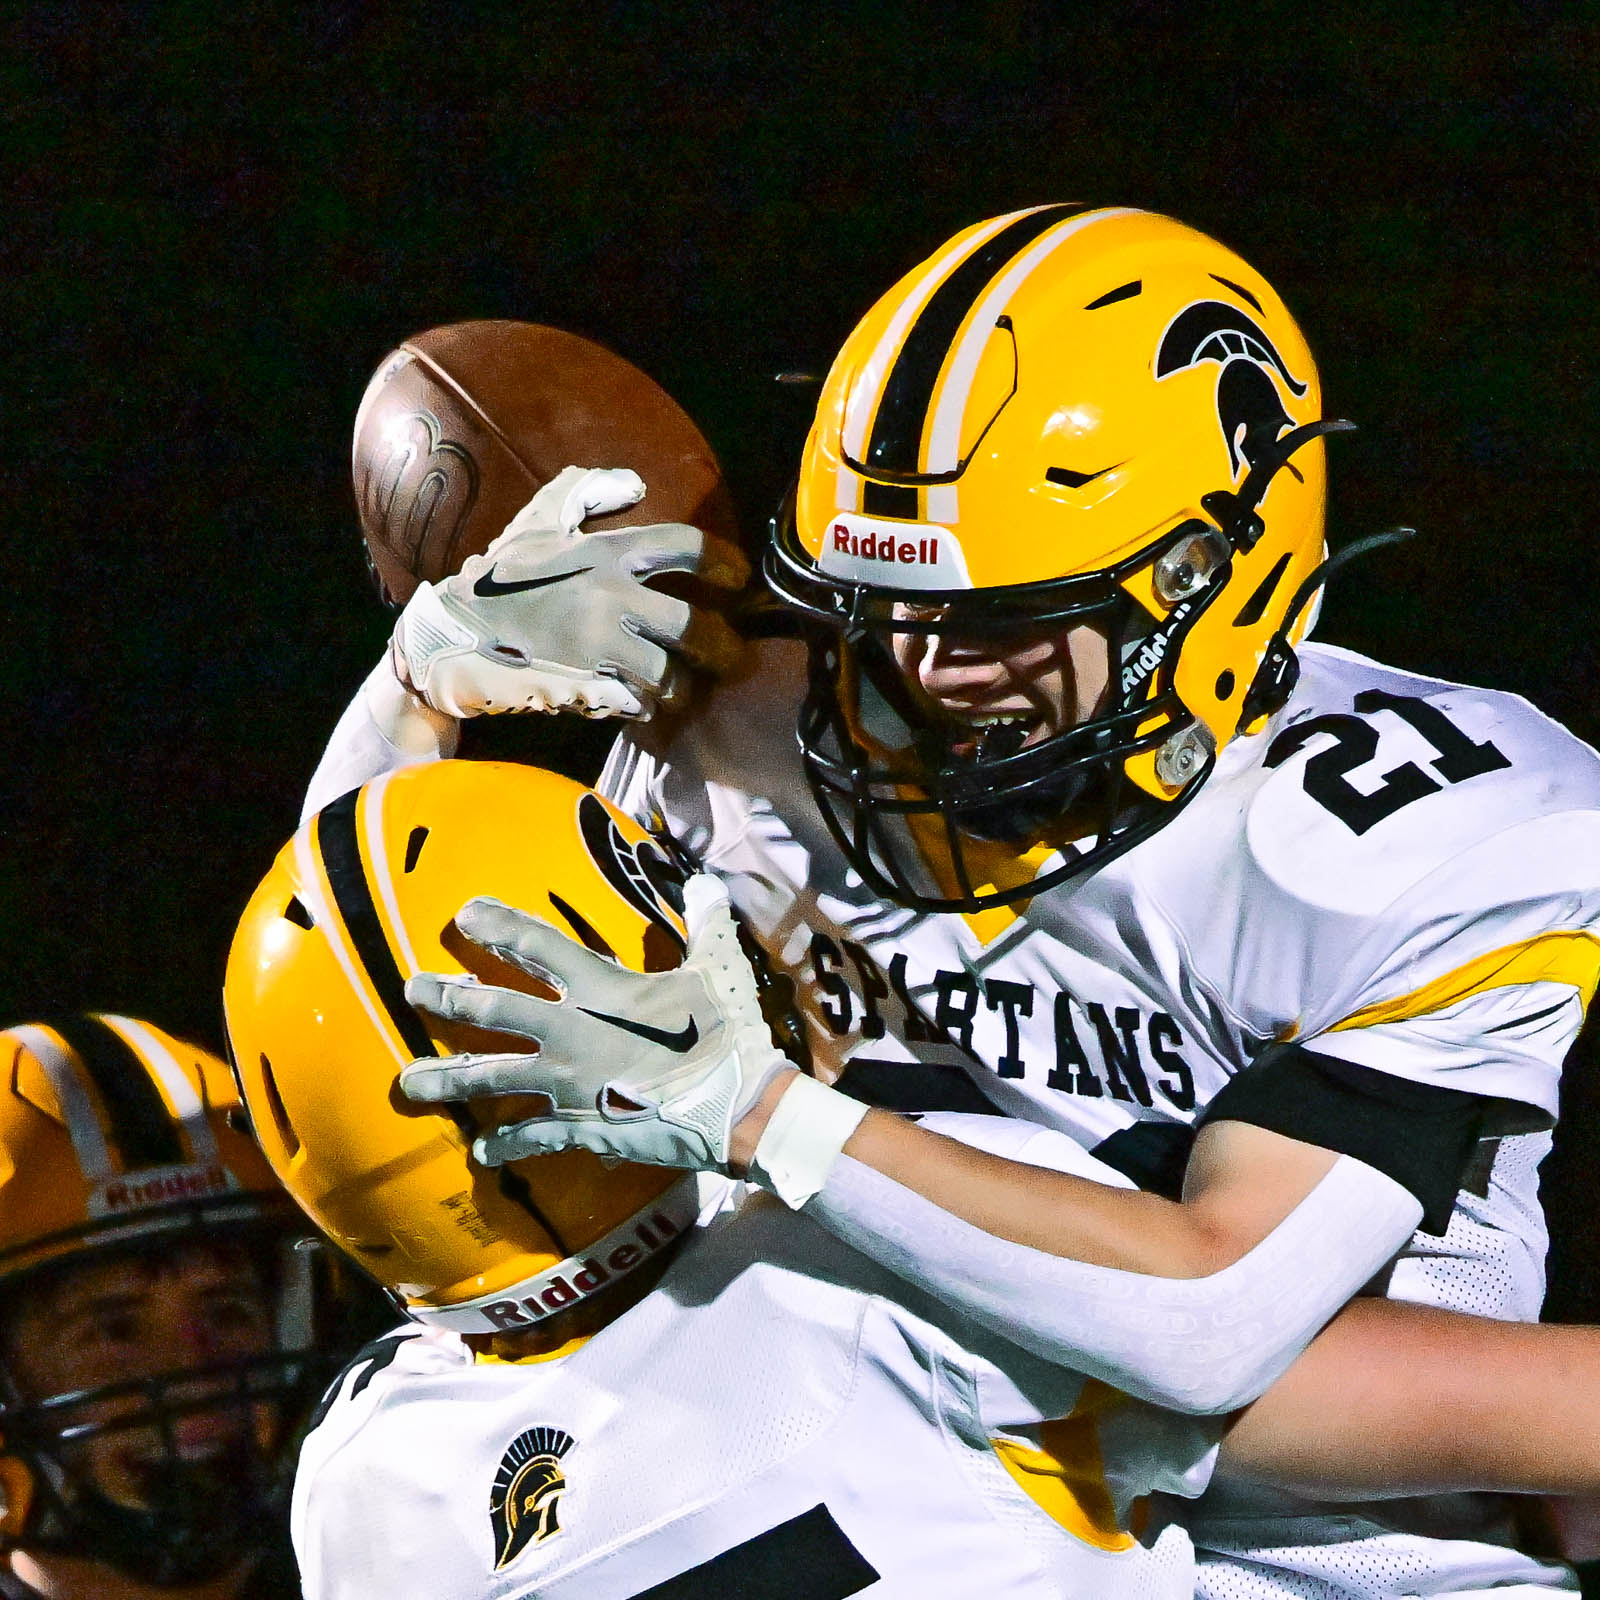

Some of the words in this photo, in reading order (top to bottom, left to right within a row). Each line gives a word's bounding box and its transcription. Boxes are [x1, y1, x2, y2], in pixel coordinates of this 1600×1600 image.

[833, 524, 938, 566] Riddell
[1262, 687, 1513, 837] 21
[810, 932, 1197, 1112] SPARTANS
[479, 1213, 679, 1330] Riddell
